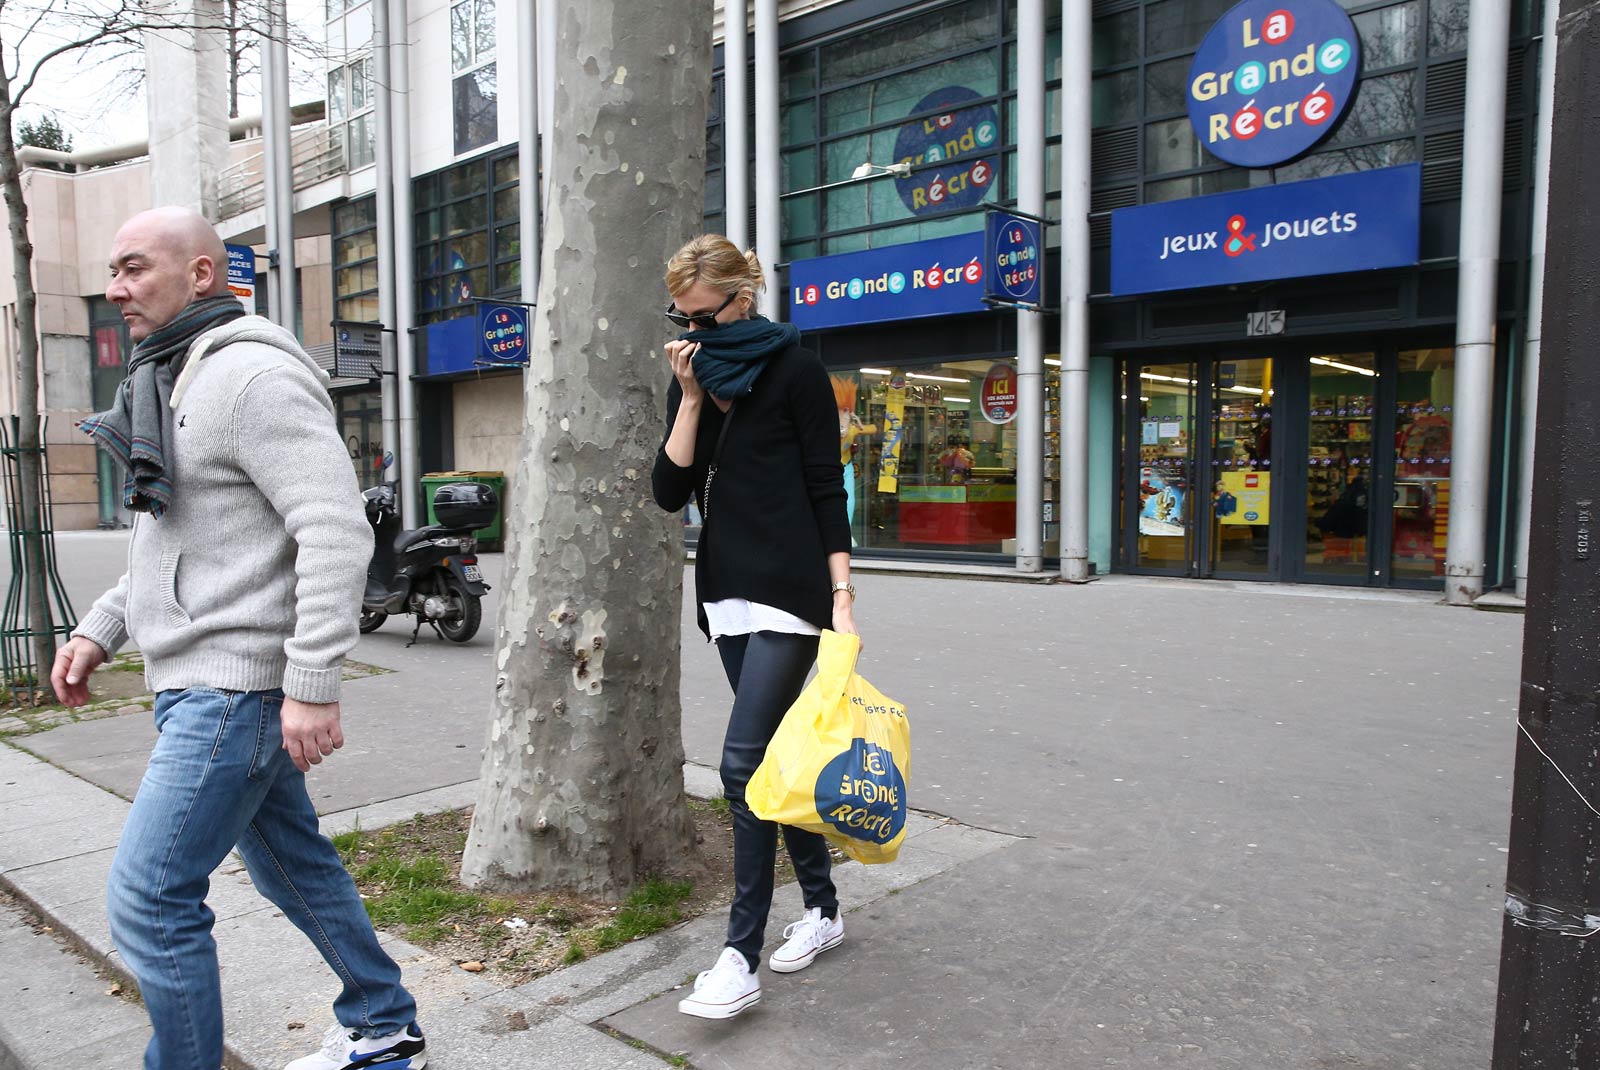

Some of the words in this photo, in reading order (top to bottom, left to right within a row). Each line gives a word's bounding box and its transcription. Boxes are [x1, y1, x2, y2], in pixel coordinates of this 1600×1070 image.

[1242, 12, 1291, 48] La
[1191, 41, 1347, 102] Grande
[1209, 82, 1334, 144] Récré
[912, 160, 988, 210] Récré
[1008, 230, 1022, 244] La
[1224, 214, 1256, 257] &
[997, 246, 1035, 267] Grande
[795, 286, 818, 304] La
[826, 264, 904, 300] Grande
[913, 256, 980, 289] Récré
[1005, 264, 1034, 287] Récré
[495, 314, 508, 323] La
[486, 323, 523, 340] Grande
[492, 336, 523, 353] Récré
[992, 380, 1008, 394] ICI
